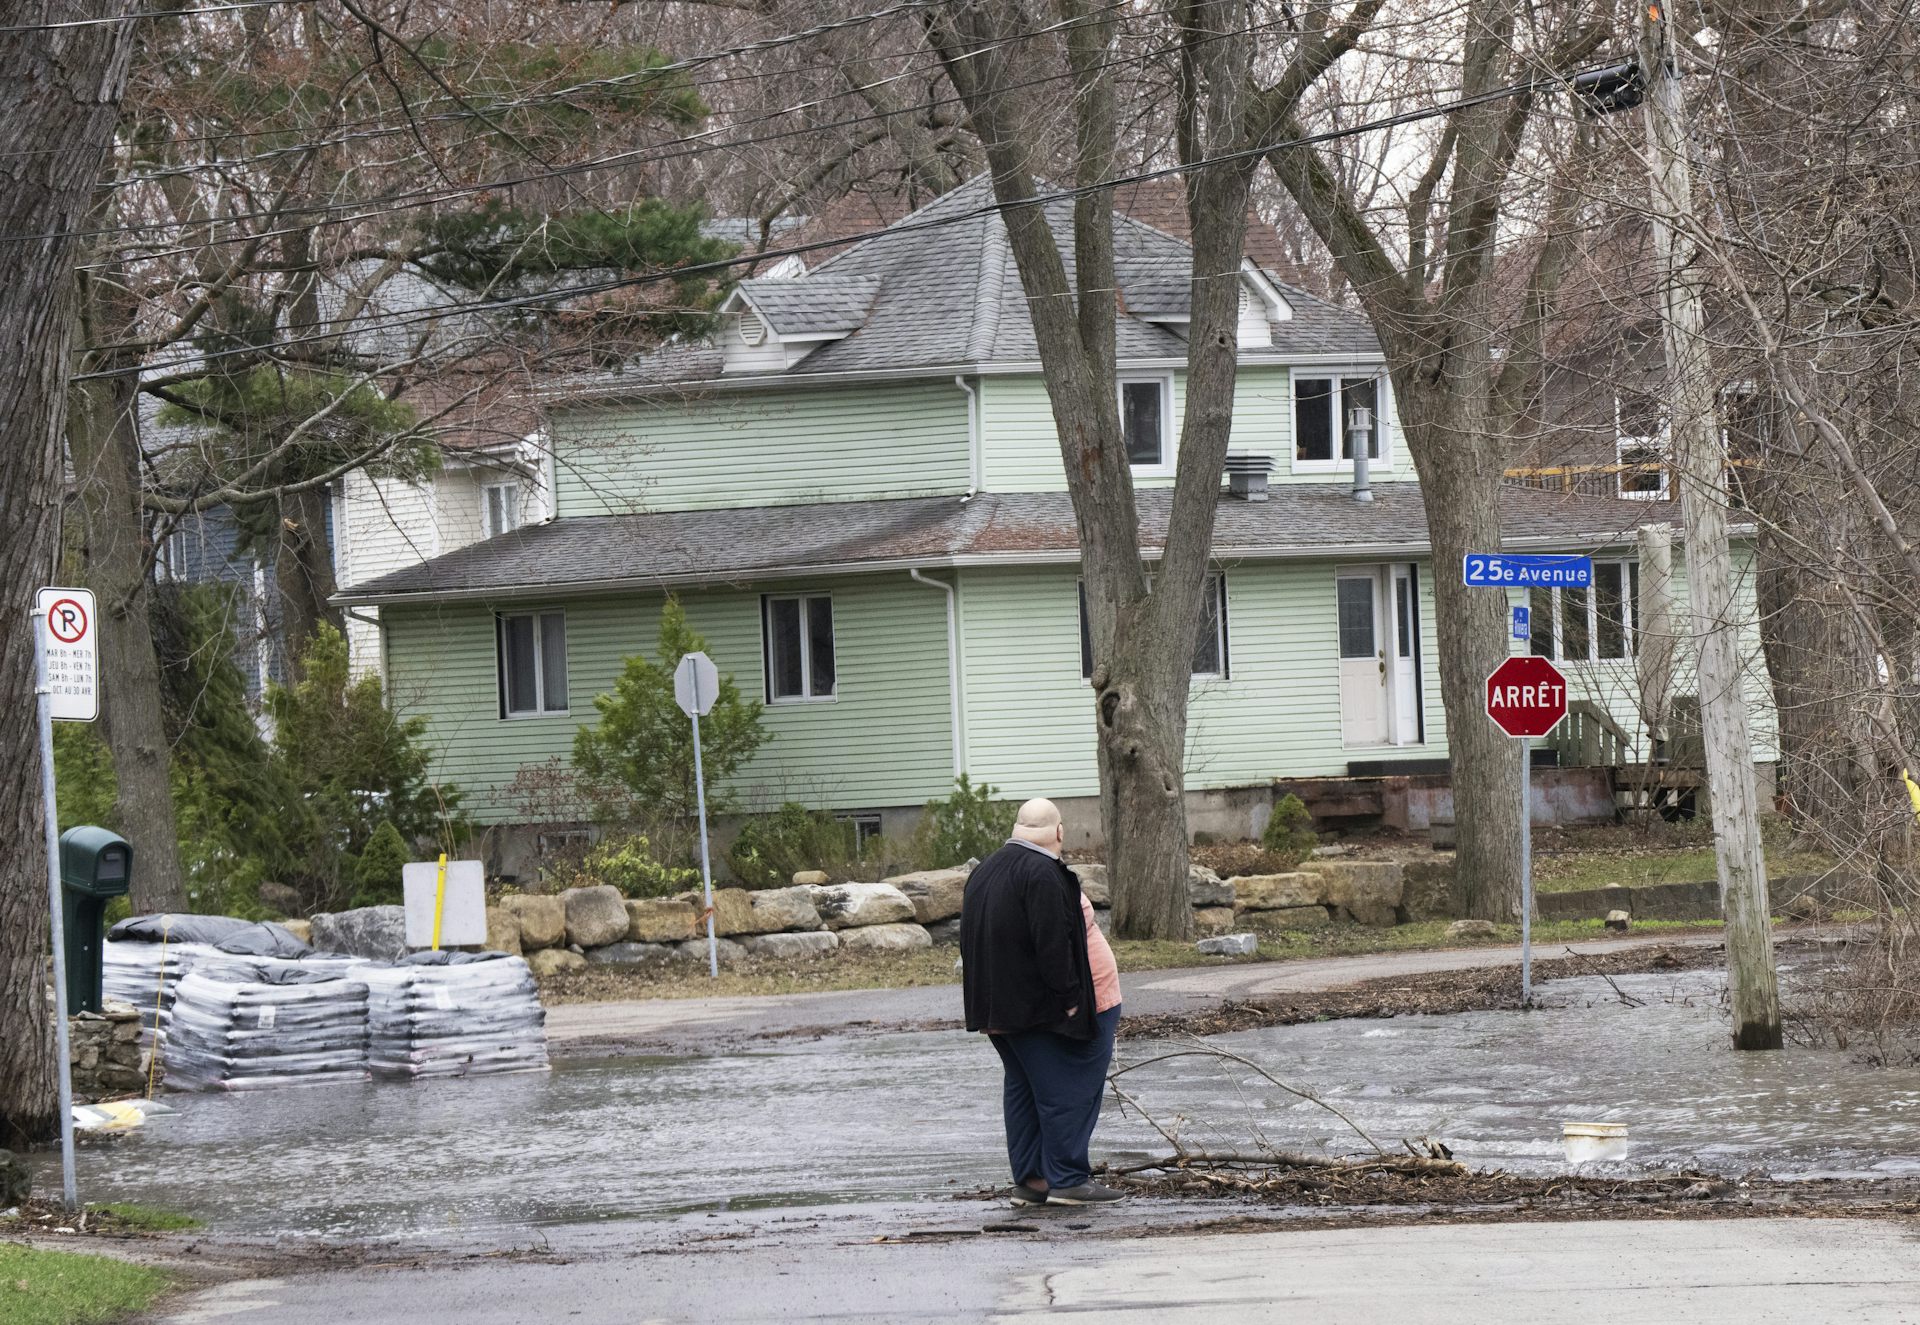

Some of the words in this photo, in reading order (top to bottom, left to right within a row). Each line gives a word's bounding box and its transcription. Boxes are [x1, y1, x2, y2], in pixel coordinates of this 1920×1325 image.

[1469, 560, 1514, 581] 25e
[1518, 567, 1587, 581] Avenue
[1490, 681, 1563, 708] ARRÊT
